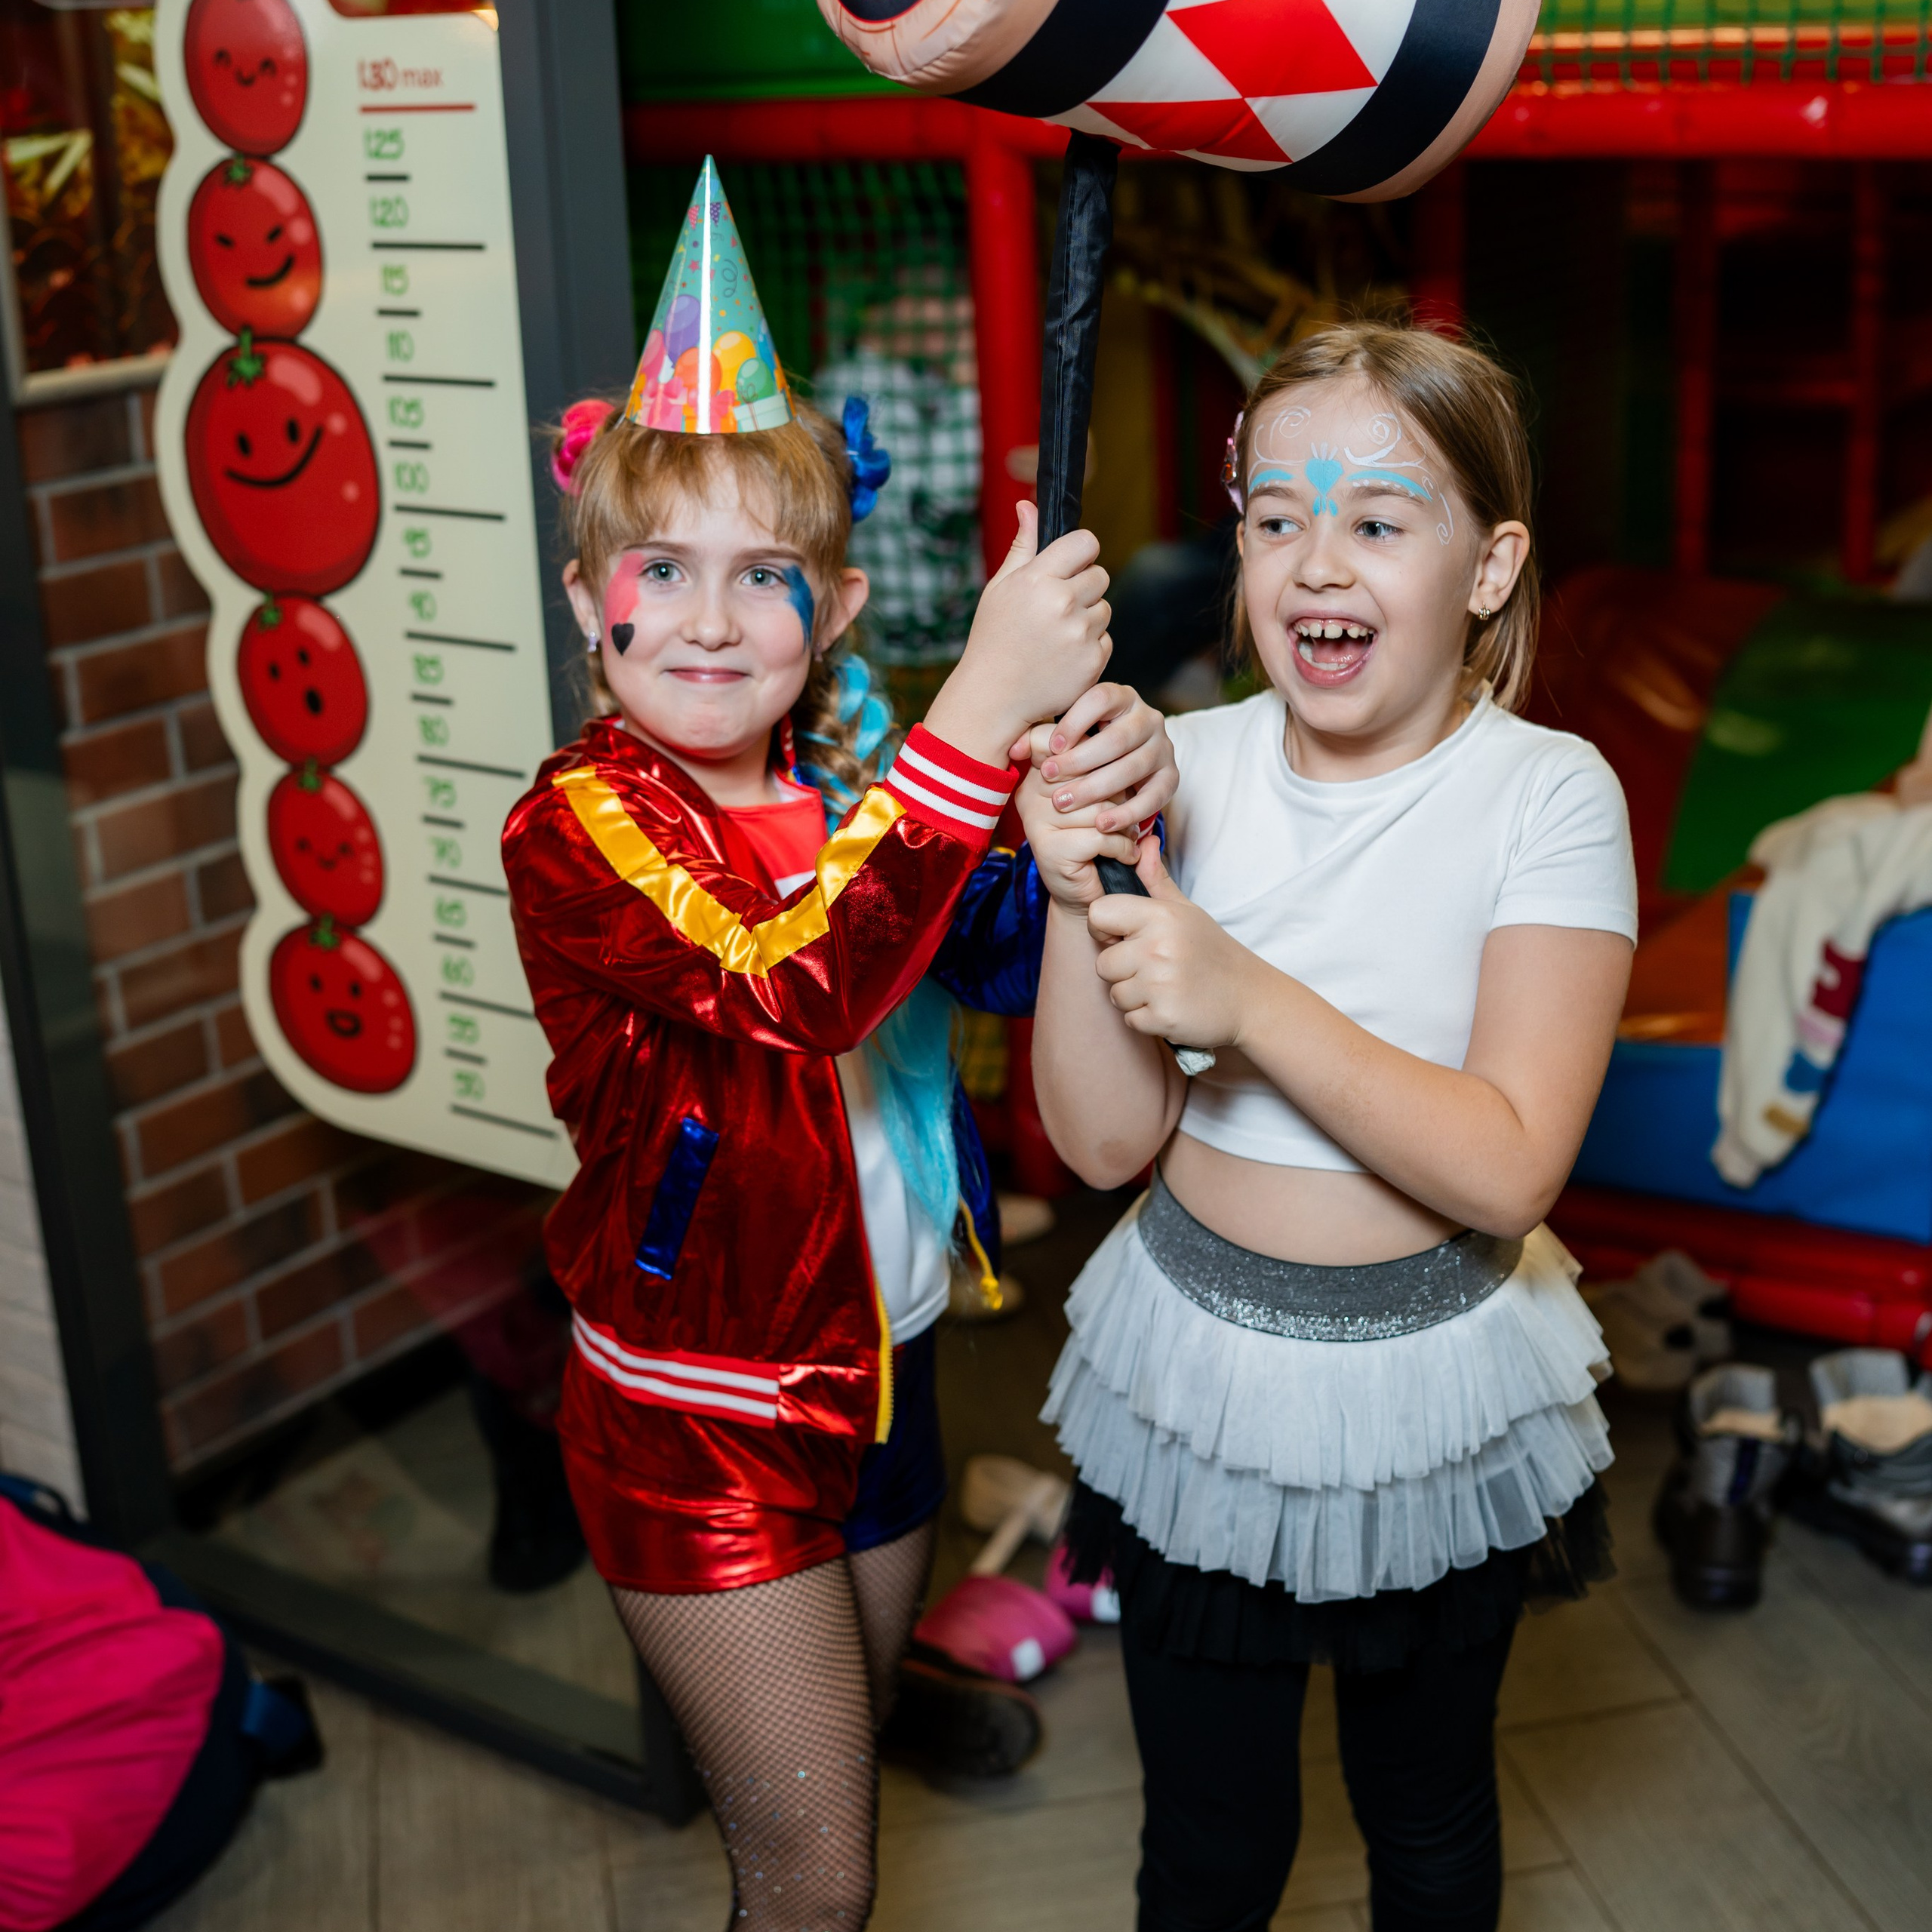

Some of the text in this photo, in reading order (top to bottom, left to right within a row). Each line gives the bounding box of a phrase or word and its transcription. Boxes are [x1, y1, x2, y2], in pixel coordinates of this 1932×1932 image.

[401, 67, 443, 89] max
[364, 128, 405, 161] 125
[370, 196, 408, 229] 120
